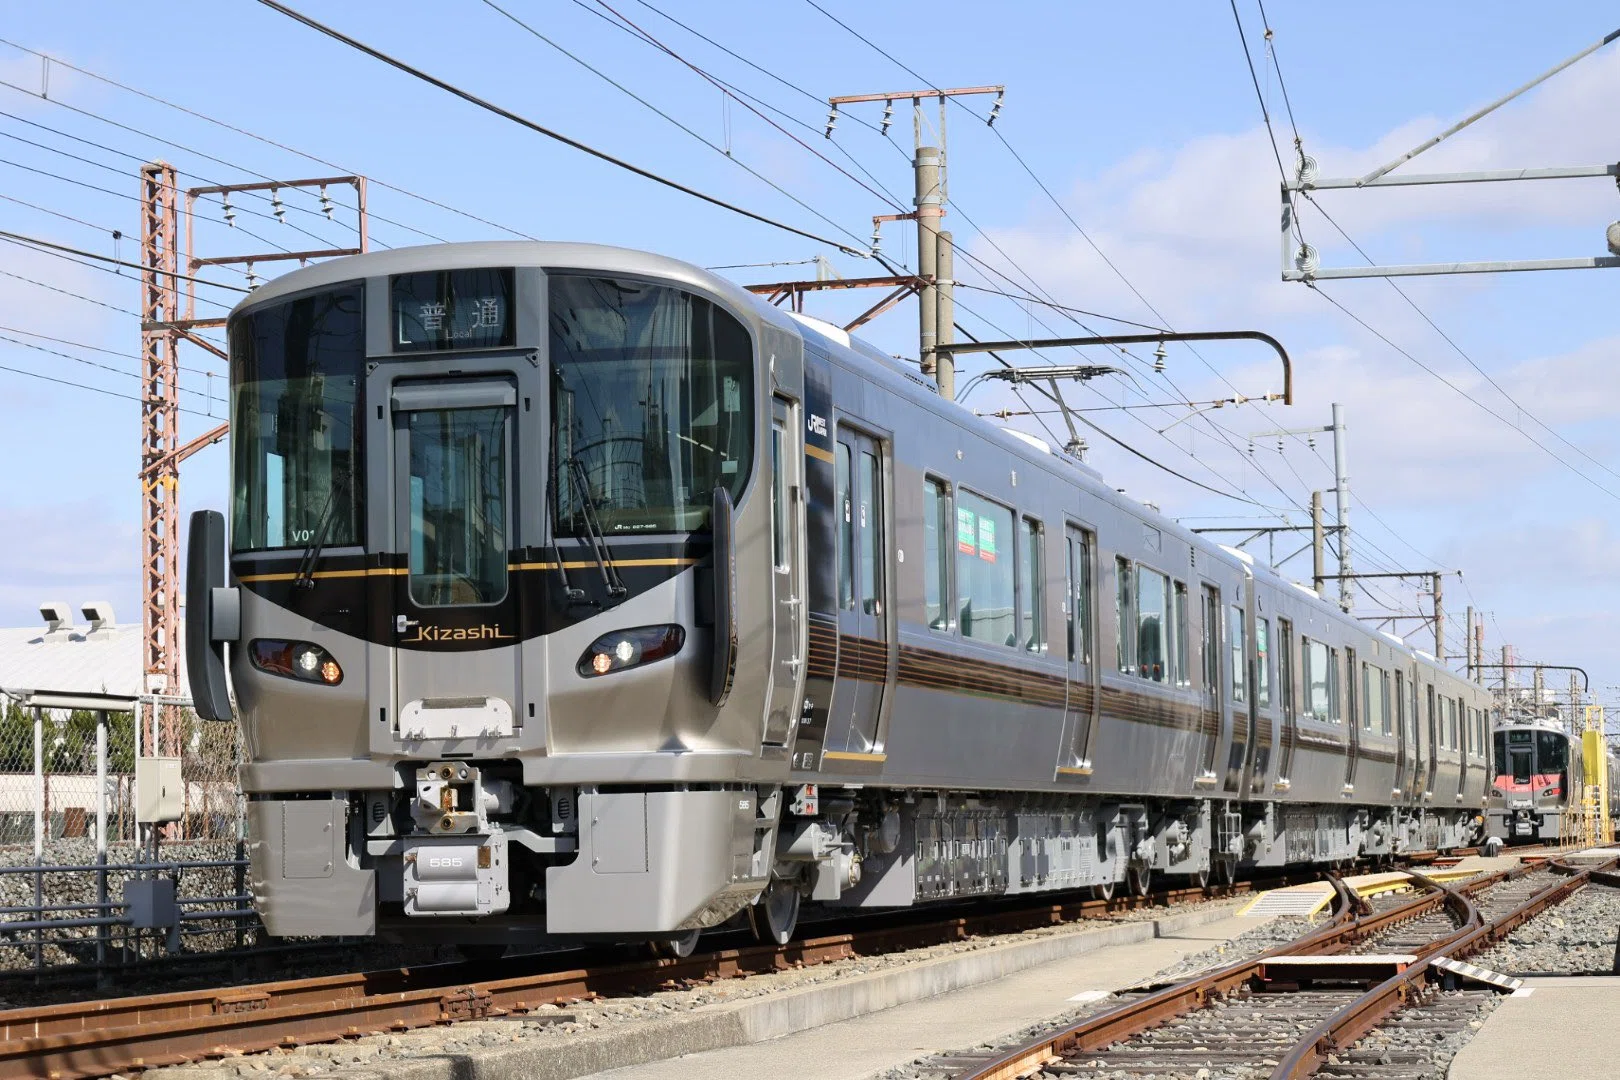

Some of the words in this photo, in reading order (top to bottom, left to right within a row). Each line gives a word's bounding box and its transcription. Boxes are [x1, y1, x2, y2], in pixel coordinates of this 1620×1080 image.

[419, 298, 499, 330] 普通
[445, 328, 472, 339] Local
[417, 623, 501, 641] Kizashi
[429, 857, 463, 868] 585
